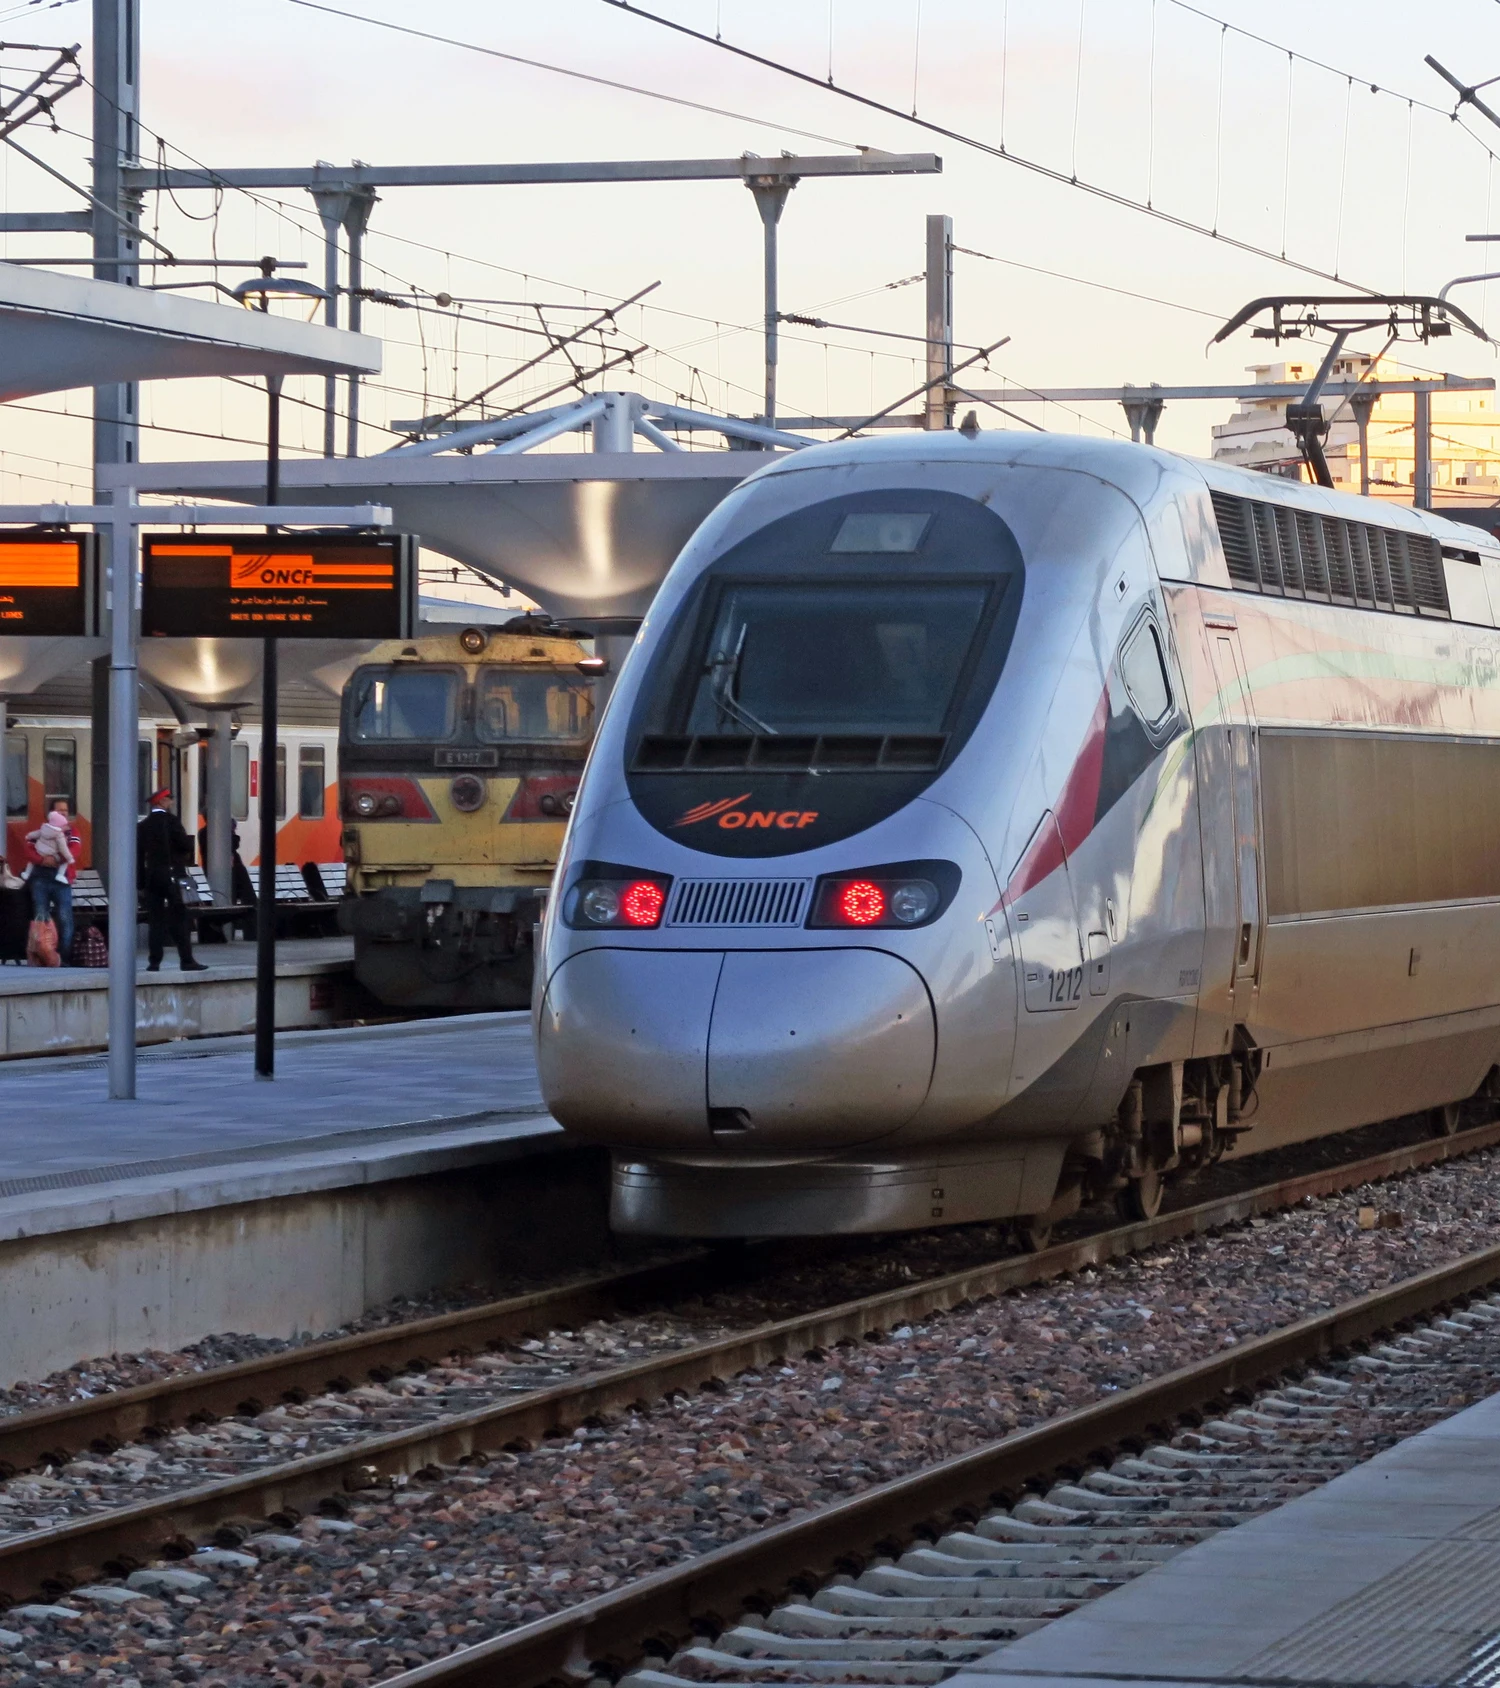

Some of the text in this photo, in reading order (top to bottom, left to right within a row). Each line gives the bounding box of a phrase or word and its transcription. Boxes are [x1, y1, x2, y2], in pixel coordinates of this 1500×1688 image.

[261, 569, 313, 584] ONCF
[447, 752, 453, 764] E
[718, 811, 819, 829] ONCF
[1048, 967, 1083, 1002] 1212
